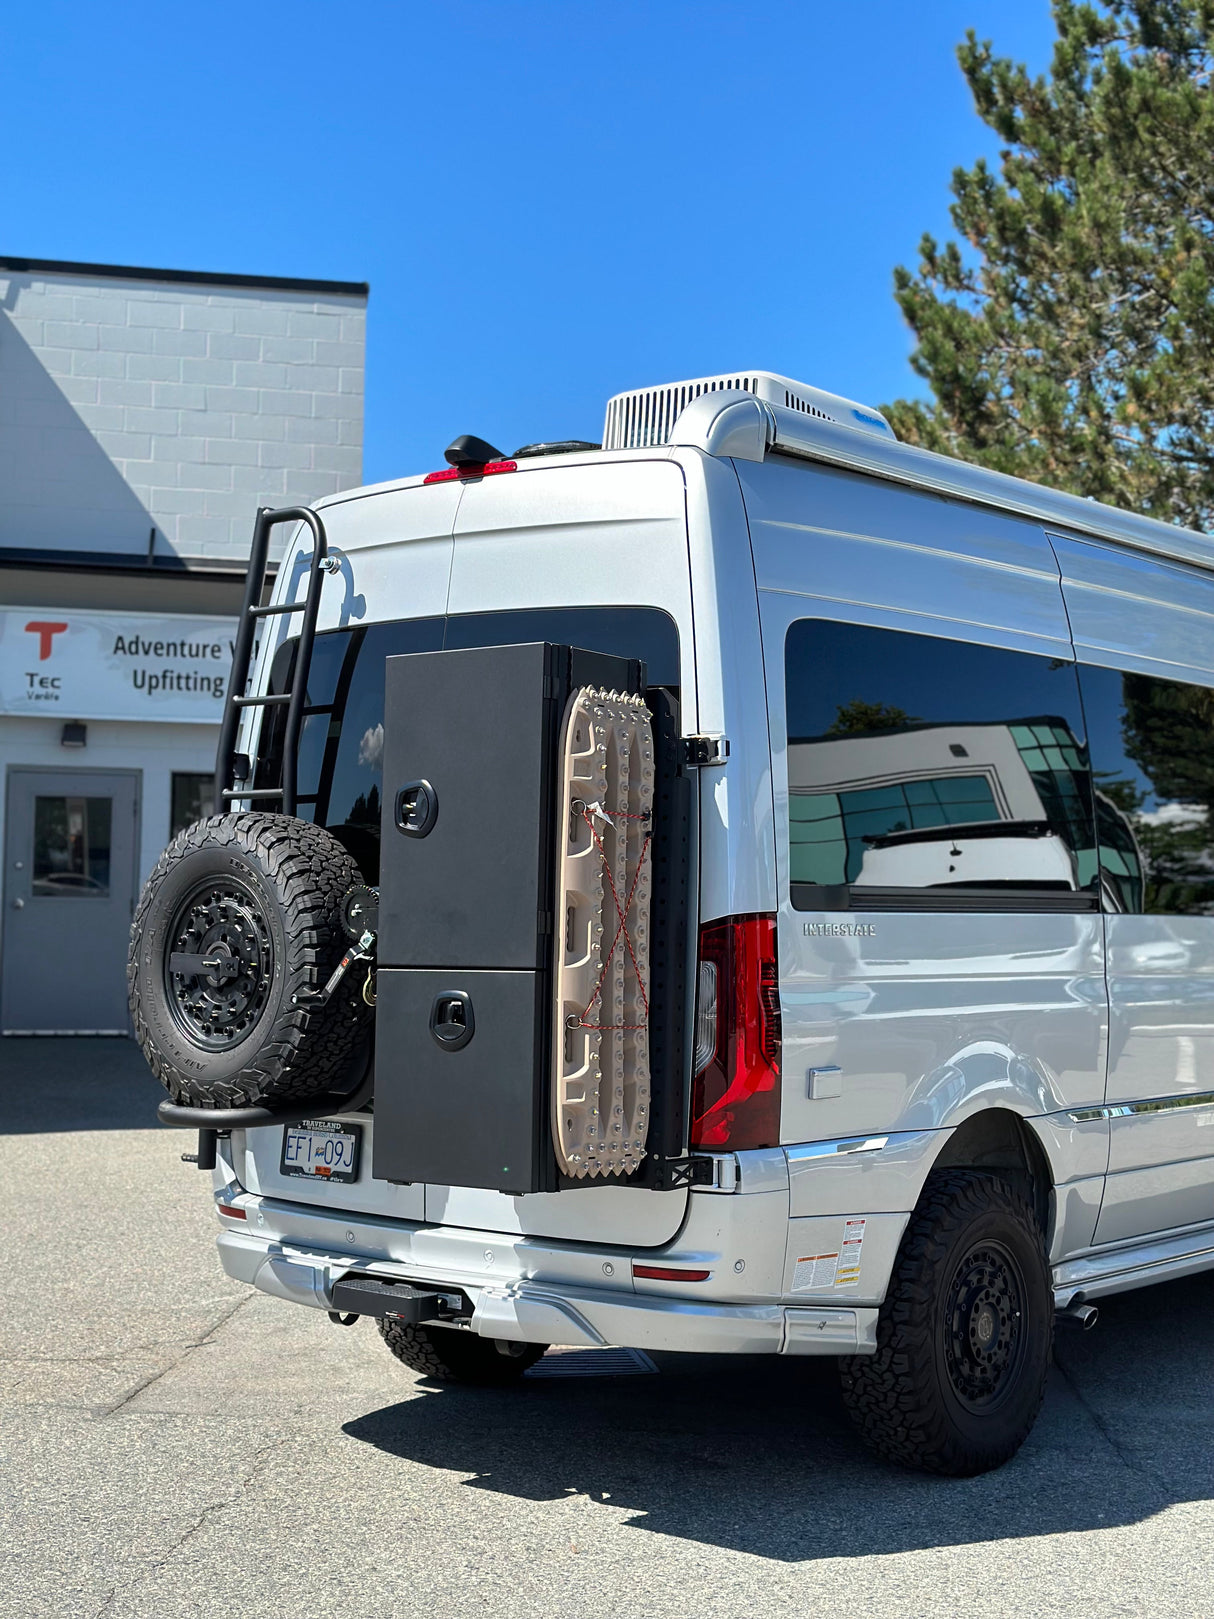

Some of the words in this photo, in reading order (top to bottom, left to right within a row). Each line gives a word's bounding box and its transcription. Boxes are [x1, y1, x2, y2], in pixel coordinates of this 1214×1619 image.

[113, 634, 222, 660] Adventure
[132, 668, 225, 698] Upfitting
[803, 922, 876, 937] INTERSTATE
[286, 1135, 313, 1162] EF1
